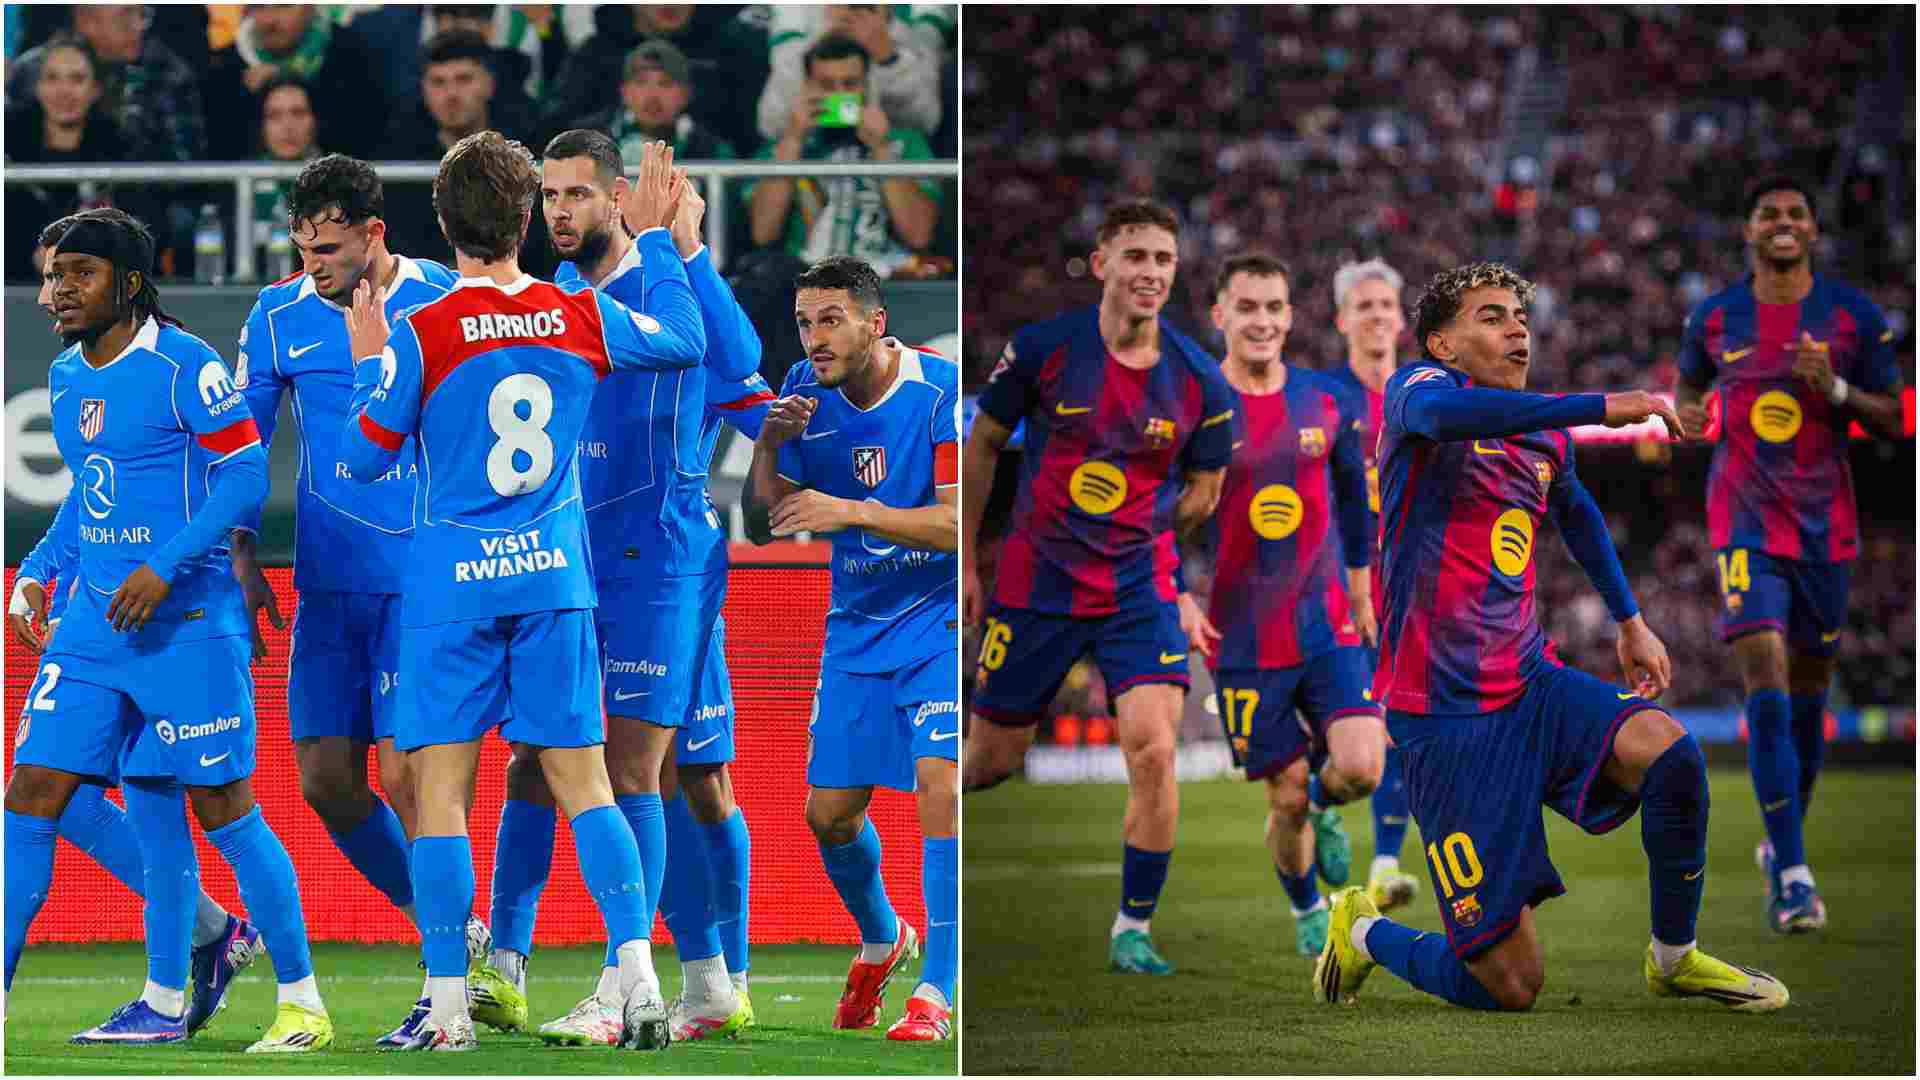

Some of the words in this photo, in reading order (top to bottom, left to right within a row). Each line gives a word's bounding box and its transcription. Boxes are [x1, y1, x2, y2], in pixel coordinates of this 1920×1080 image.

[460, 308, 566, 342] BARRIOS
[486, 373, 554, 497] 8
[586, 442, 608, 459] AIR
[119, 526, 152, 544] AIR
[479, 530, 540, 556] VISIT
[455, 548, 568, 583] RWANDA
[1717, 547, 1751, 593] 14
[178, 716, 241, 740] ComAve
[1222, 687, 1260, 736] 17
[1427, 832, 1484, 898] 10
